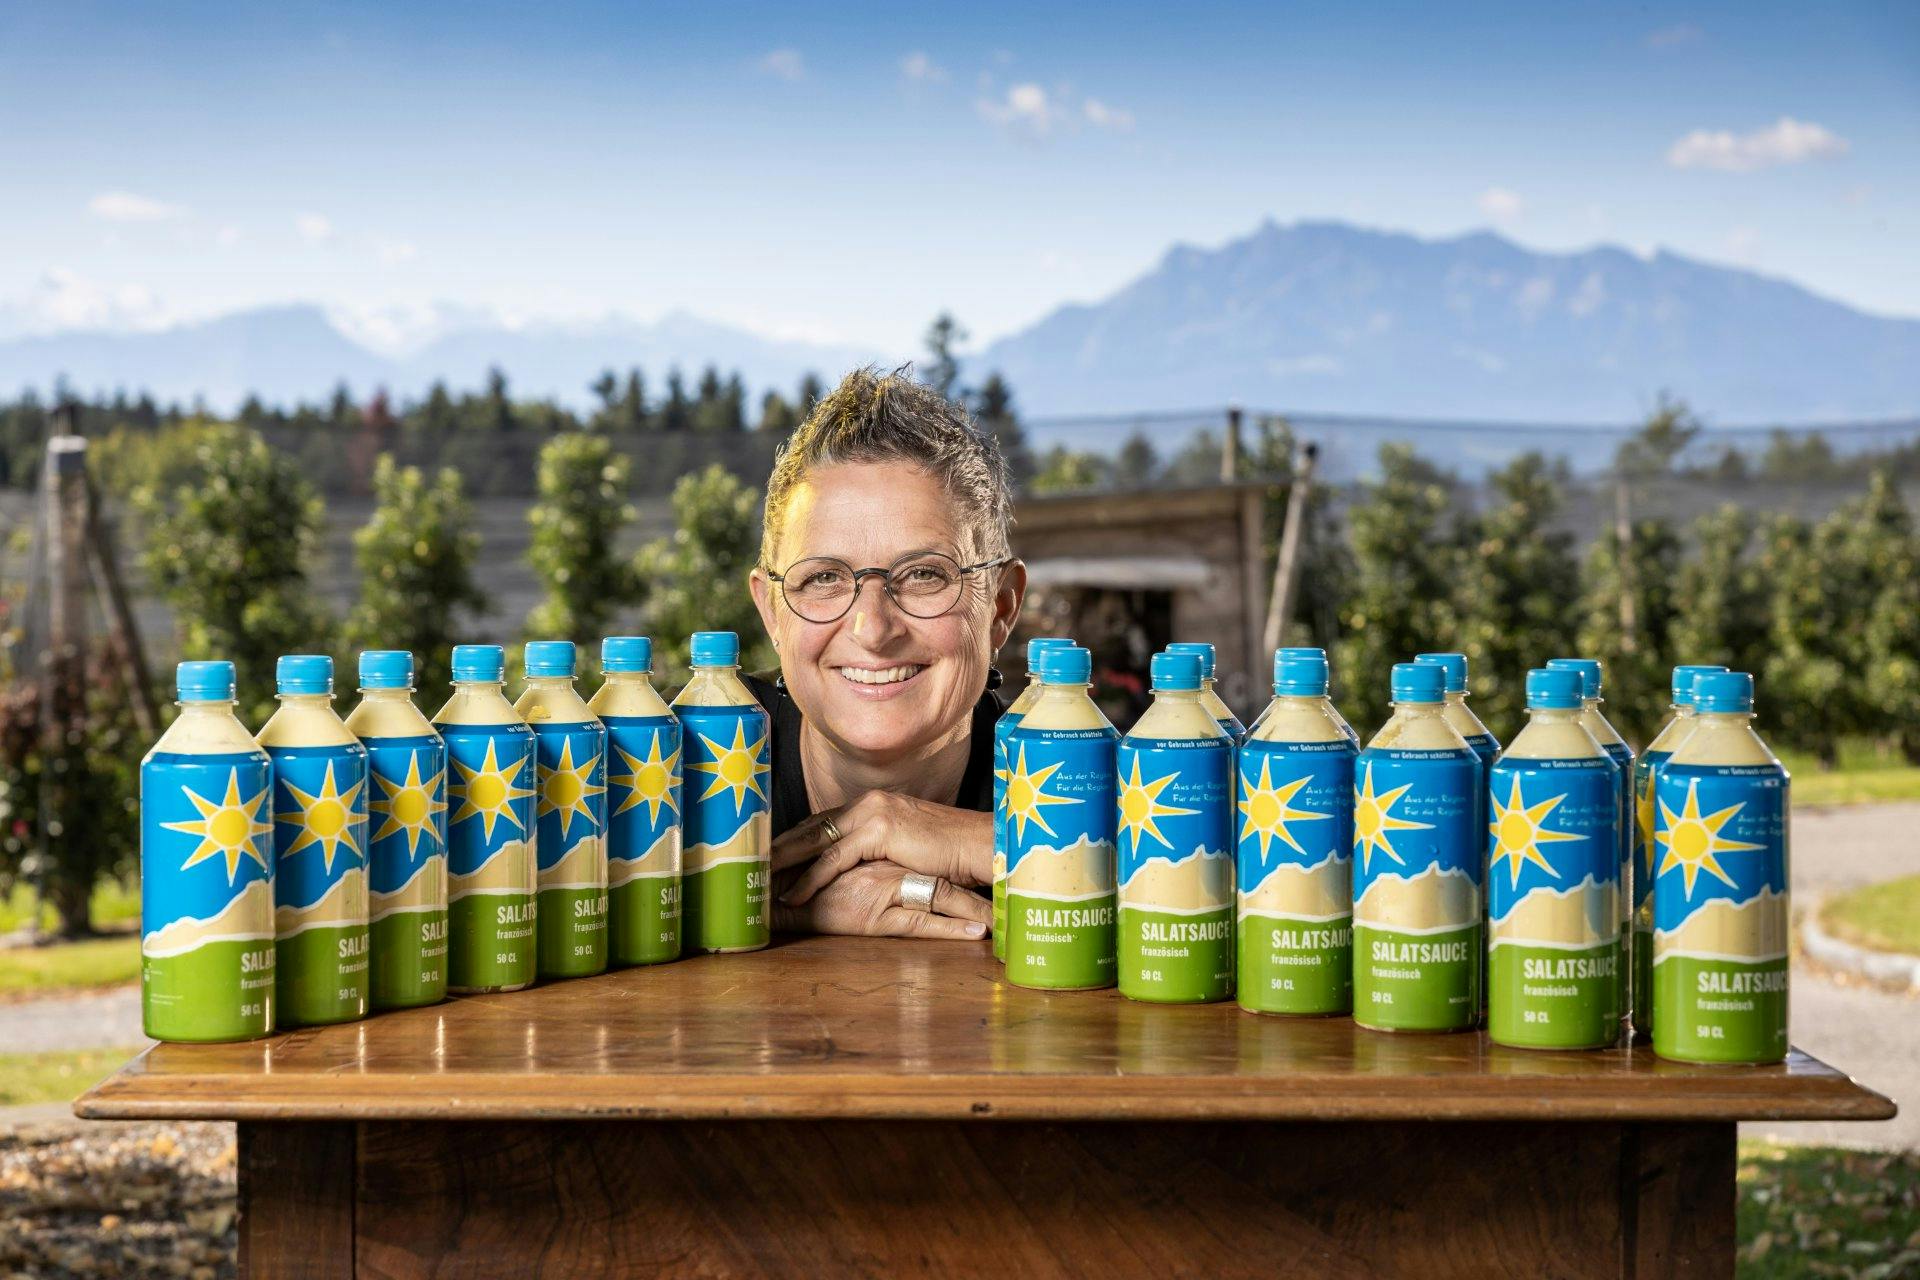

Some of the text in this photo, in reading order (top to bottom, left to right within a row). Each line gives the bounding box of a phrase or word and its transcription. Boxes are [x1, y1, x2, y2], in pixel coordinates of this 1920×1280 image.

[1401, 751, 1428, 759] Gebrauch
[1056, 772, 1073, 780] Aus
[1056, 783, 1071, 792] Für
[1172, 782, 1190, 791] Aus
[1305, 786, 1323, 795] Aus
[1189, 793, 1201, 802] die
[1404, 794, 1422, 803] Aus
[746, 917, 755, 926] 50
[1026, 907, 1113, 928] SALATSAUCE
[496, 926, 533, 940] französisch
[660, 933, 668, 943] 50
[1025, 930, 1073, 944] französisch
[1141, 921, 1231, 942] SALATSAUCE
[574, 945, 594, 957] 50 CL
[1141, 945, 1190, 958] französisch
[1371, 940, 1468, 963] SALATSAUCE
[496, 952, 518, 964] 50 CL
[1026, 955, 1047, 967] 50 CL
[1271, 953, 1322, 966] französisch
[421, 970, 440, 983] 50 CL
[1141, 969, 1163, 982] 50 CL
[1371, 965, 1422, 980] französisch
[1271, 978, 1295, 991] 50 CL
[1523, 983, 1579, 997] französisch
[338, 987, 358, 1001] 50 CL
[1371, 991, 1394, 1005] 50 CL
[240, 1003, 262, 1017] 50 CL
[1524, 1010, 1551, 1024] 50 CL
[1696, 1024, 1726, 1040] 50 CL
